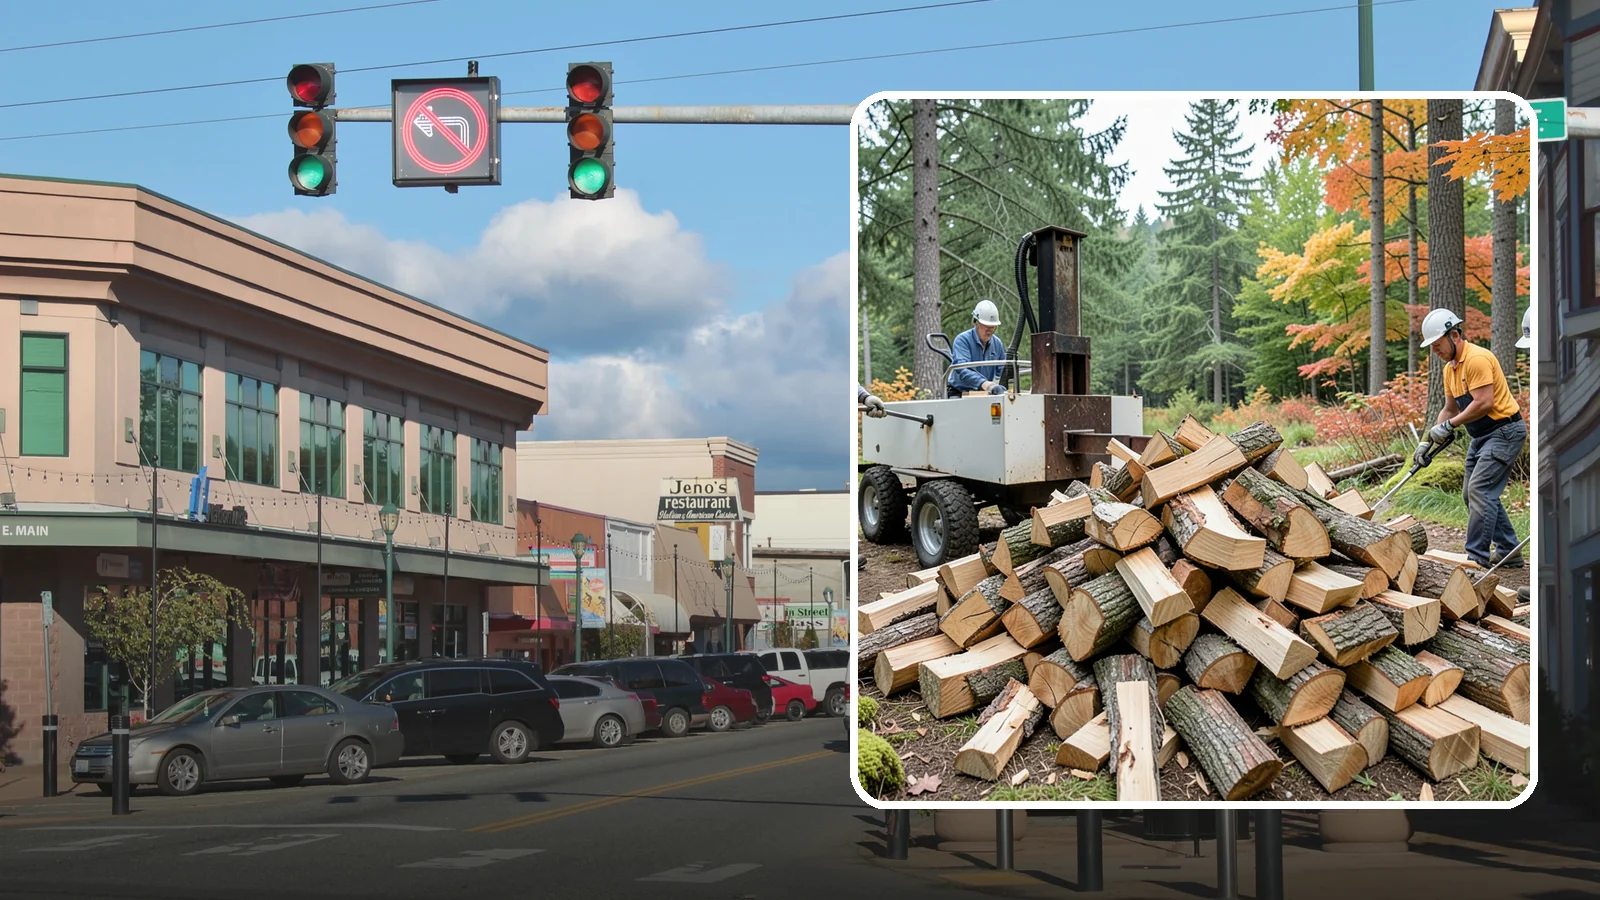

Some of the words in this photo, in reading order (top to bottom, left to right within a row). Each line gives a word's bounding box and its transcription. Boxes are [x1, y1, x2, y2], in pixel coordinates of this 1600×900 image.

[669, 480, 727, 495] Jeno's
[665, 496, 731, 509] restaurant
[659, 510, 681, 520] Italian
[686, 509, 714, 519] American
[715, 509, 737, 519] Cuisine
[2, 525, 13, 536] E.
[15, 525, 49, 536] MAIN
[797, 607, 828, 617] Street
[790, 619, 824, 627] lass
